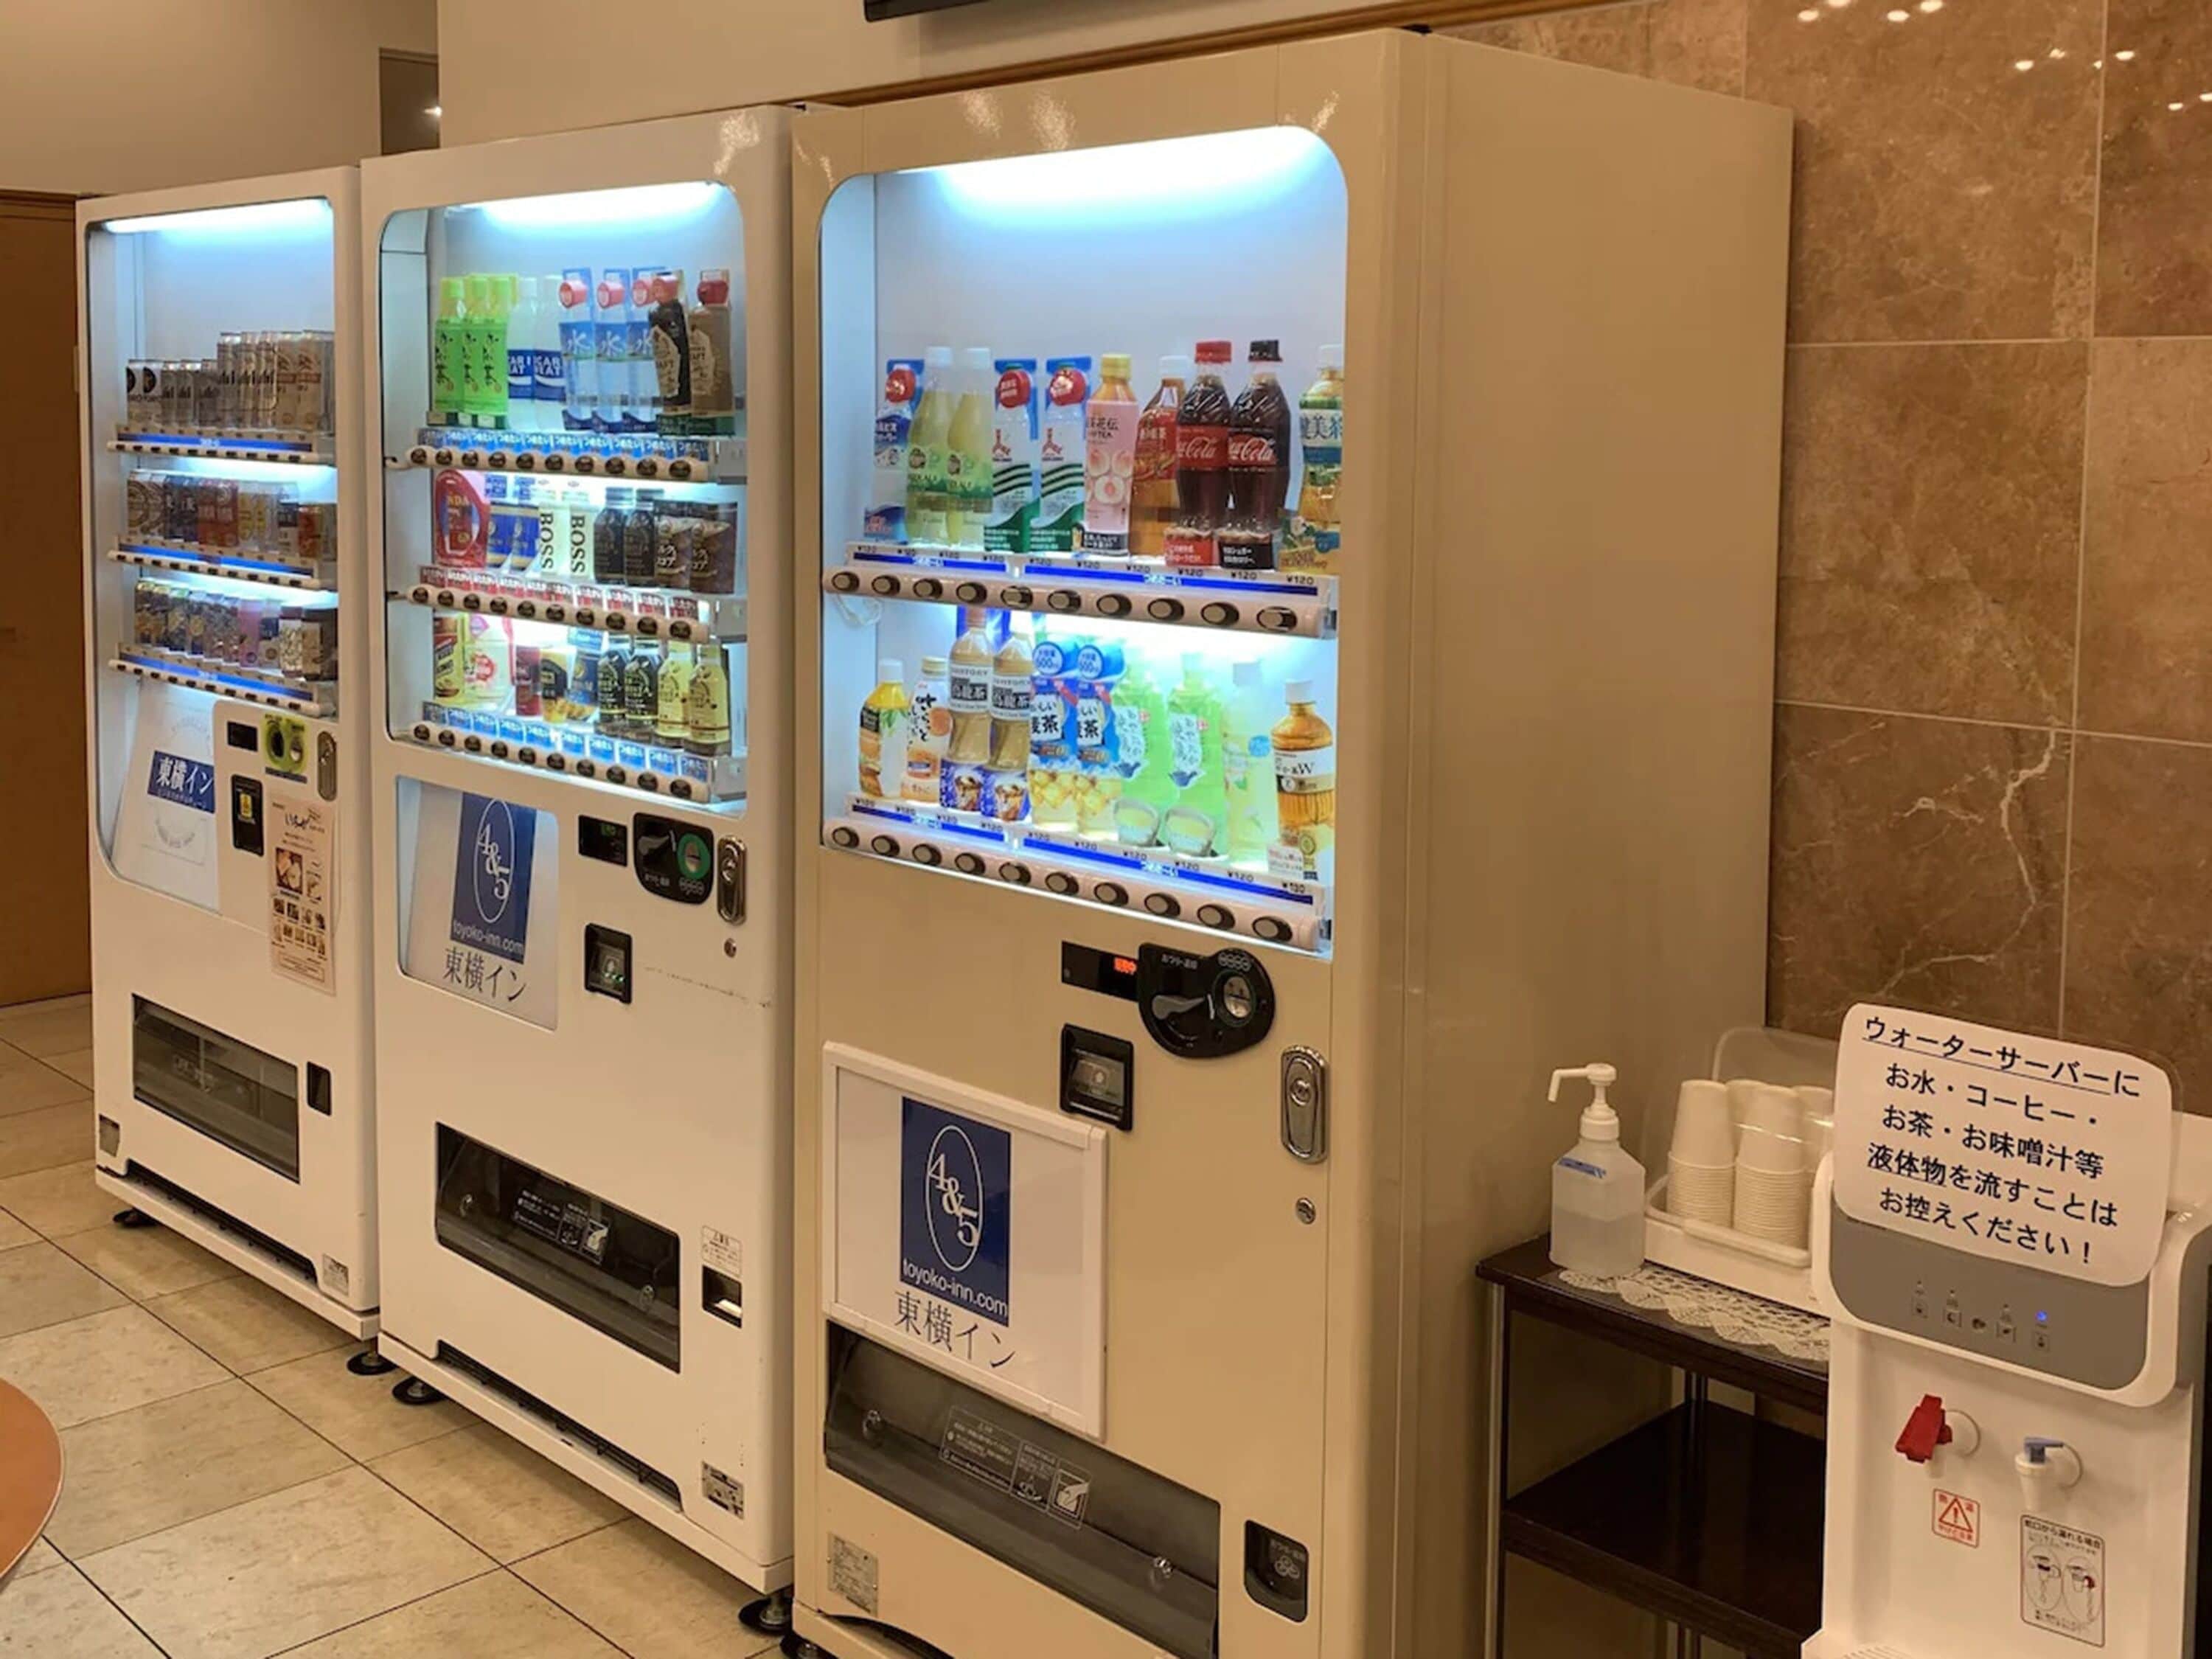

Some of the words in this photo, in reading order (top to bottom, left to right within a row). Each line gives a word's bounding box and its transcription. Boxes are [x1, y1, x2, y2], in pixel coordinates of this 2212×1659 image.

[566, 329, 589, 355] 水
[600, 330, 624, 356] 水
[539, 512, 554, 570] BOSS
[570, 515, 586, 574] BOSS
[1077, 561, 1101, 570] ¥120
[1127, 564, 1152, 574] ¥120
[1178, 568, 1203, 577] ¥120
[1231, 571, 1258, 581] ¥120
[1287, 575, 1315, 585] ¥120
[156, 756, 214, 796] 東横イン
[981, 822, 1003, 832] ¥120
[1074, 841, 1097, 851] ¥120
[1123, 850, 1147, 861] ¥120
[1175, 860, 1200, 871] ¥120
[1228, 871, 1253, 883] ¥120
[453, 919, 525, 956] toyoko-inn.com
[443, 947, 527, 1004] 東横イン
[1864, 1016, 2141, 1099] ウォーターサーバーに
[1886, 1063, 2098, 1127] お水・コーヒー・
[1882, 1105, 2104, 1180] お茶・お味噌汁等
[928, 1153, 979, 1248] 4&5
[1867, 1141, 2118, 1228] 液体物を流すことは
[1879, 1187, 2092, 1264] お控えください！
[901, 1257, 1008, 1318] toyoko-inn.com
[894, 1290, 1017, 1369] 東横イン
